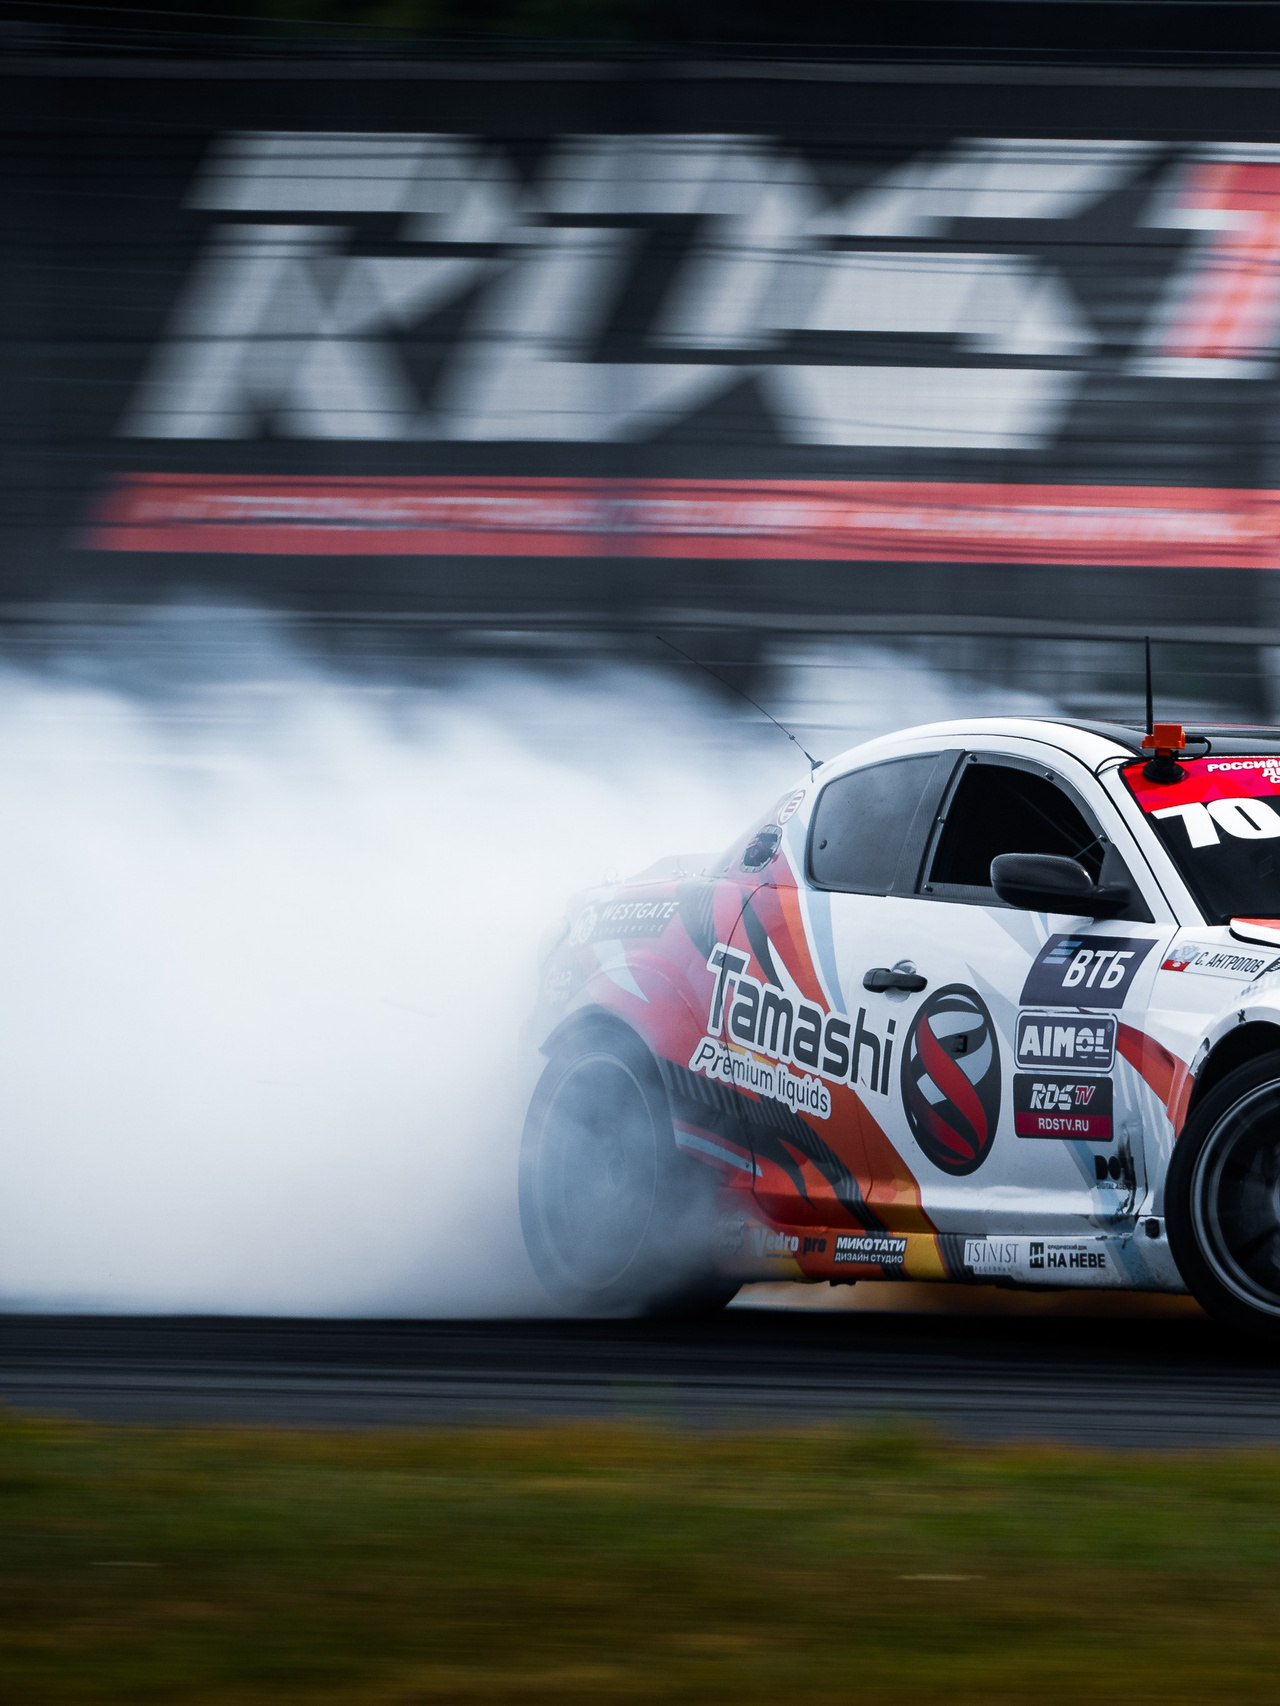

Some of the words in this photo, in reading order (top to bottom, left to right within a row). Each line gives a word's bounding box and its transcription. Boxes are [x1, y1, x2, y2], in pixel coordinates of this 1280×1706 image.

[600, 901, 680, 923] WESTGATE
[1206, 953, 1265, 974] АНТРОПОВ
[709, 947, 898, 1098] Tamashi
[695, 1042, 774, 1093] Premium
[777, 1070, 830, 1114] liquids
[1038, 1117, 1090, 1132] RDSTV.RU
[836, 1236, 907, 1252] МИКОТАТИ
[834, 1251, 869, 1263] ДИЗАЙН
[870, 1253, 904, 1264] СТУДИО
[1047, 1252, 1068, 1268] НА
[1069, 1252, 1106, 1269] НЕВЕ
